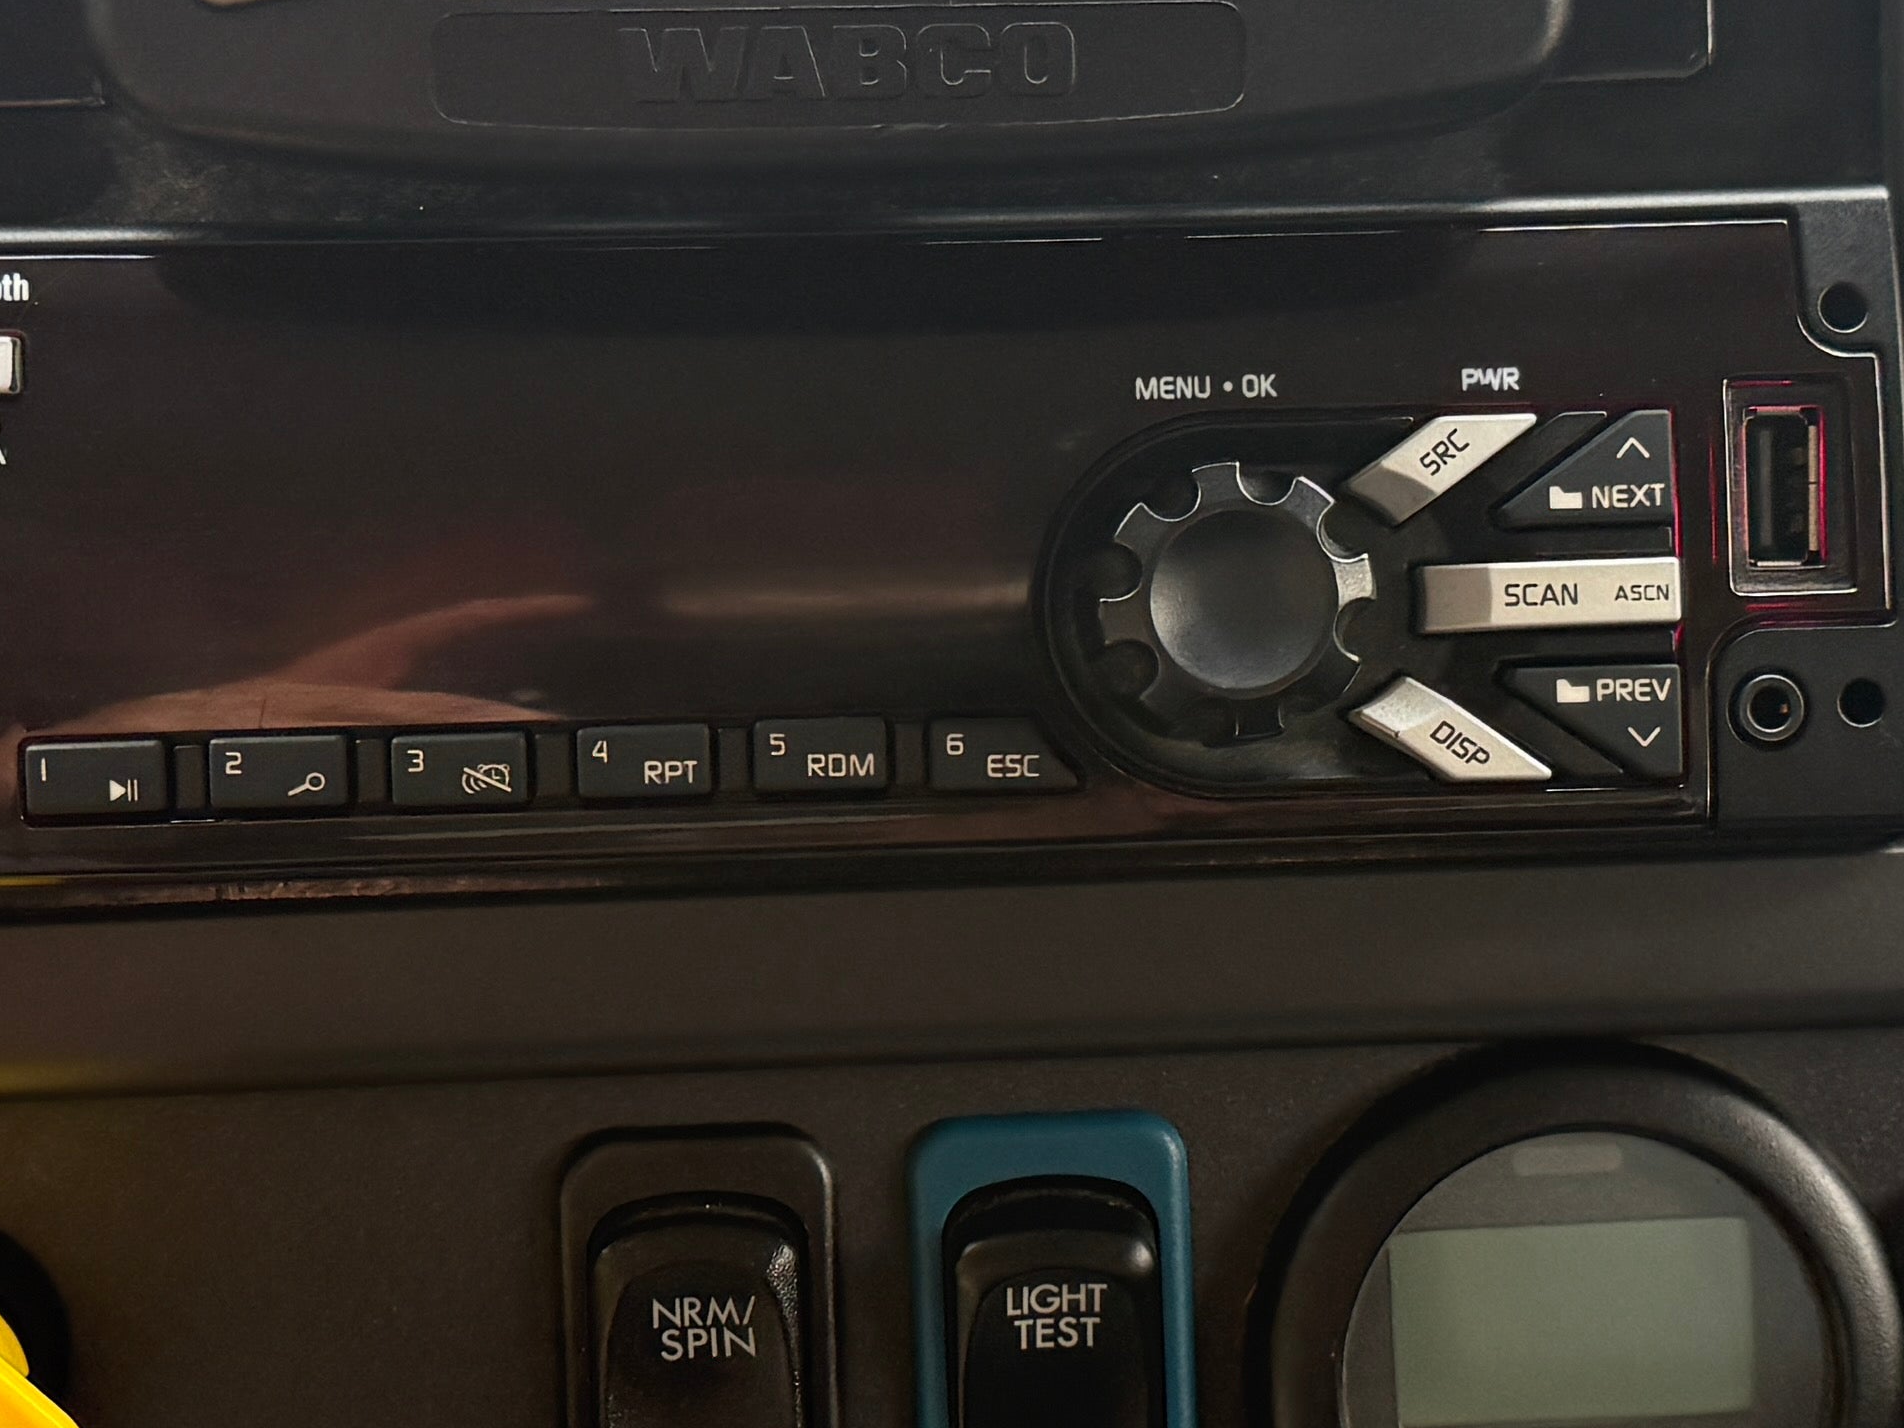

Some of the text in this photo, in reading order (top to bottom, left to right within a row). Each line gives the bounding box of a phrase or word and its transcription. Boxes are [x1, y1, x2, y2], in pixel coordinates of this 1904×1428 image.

[617, 20, 1078, 104] WABCO
[1135, 373, 1278, 401] MENU OK
[1460, 366, 1522, 393] PWR
[1418, 425, 1471, 479] SRC
[1591, 482, 1665, 510] NEXT
[1504, 580, 1670, 608] SCAN ASCN
[1595, 676, 1671, 703] PREV
[590, 739, 609, 763] 4
[769, 733, 786, 757] 5
[945, 733, 964, 757] 6
[1427, 719, 1492, 770] DISP
[38, 758, 48, 782] 1
[224, 752, 242, 776] 2
[406, 749, 425, 773] 3
[642, 759, 698, 785] RPT
[806, 751, 876, 778] RDM
[986, 753, 1040, 779] ESC
[651, 1295, 755, 1329] NRM/
[1006, 1283, 1108, 1317] LIGHT
[661, 1327, 756, 1362] SPIN
[1014, 1317, 1101, 1351] TEST
